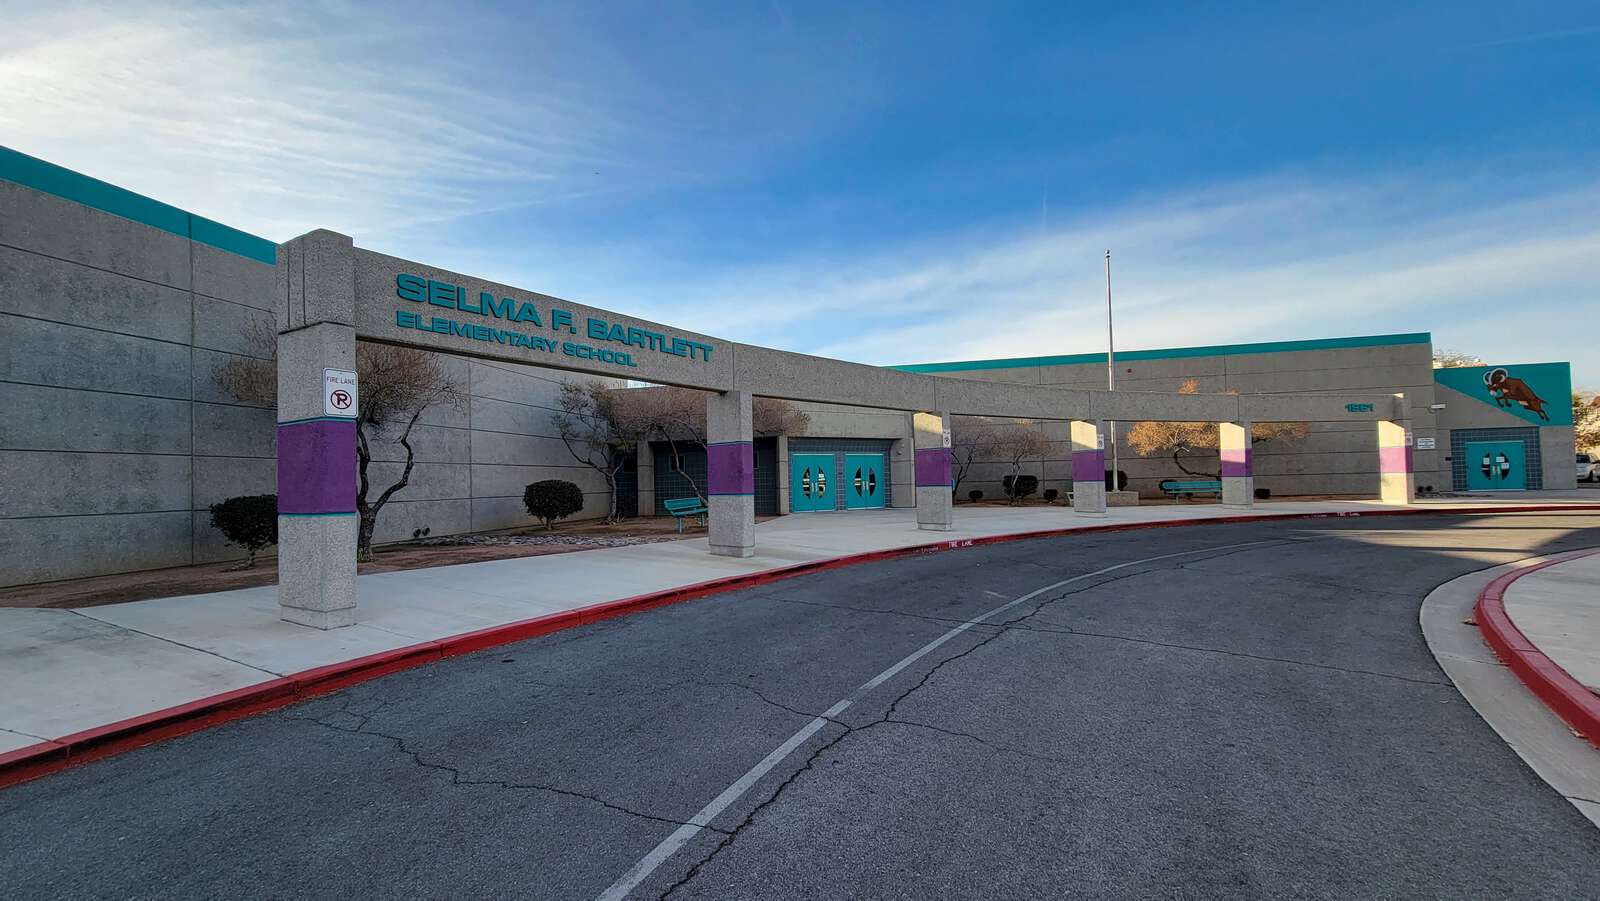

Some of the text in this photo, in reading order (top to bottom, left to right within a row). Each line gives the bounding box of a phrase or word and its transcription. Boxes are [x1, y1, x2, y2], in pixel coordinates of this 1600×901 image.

[396, 273, 713, 362] SELMA F. BARTLETT
[396, 310, 637, 367] ELEMENTARY SCHOOL
[326, 375, 338, 383] FIRE
